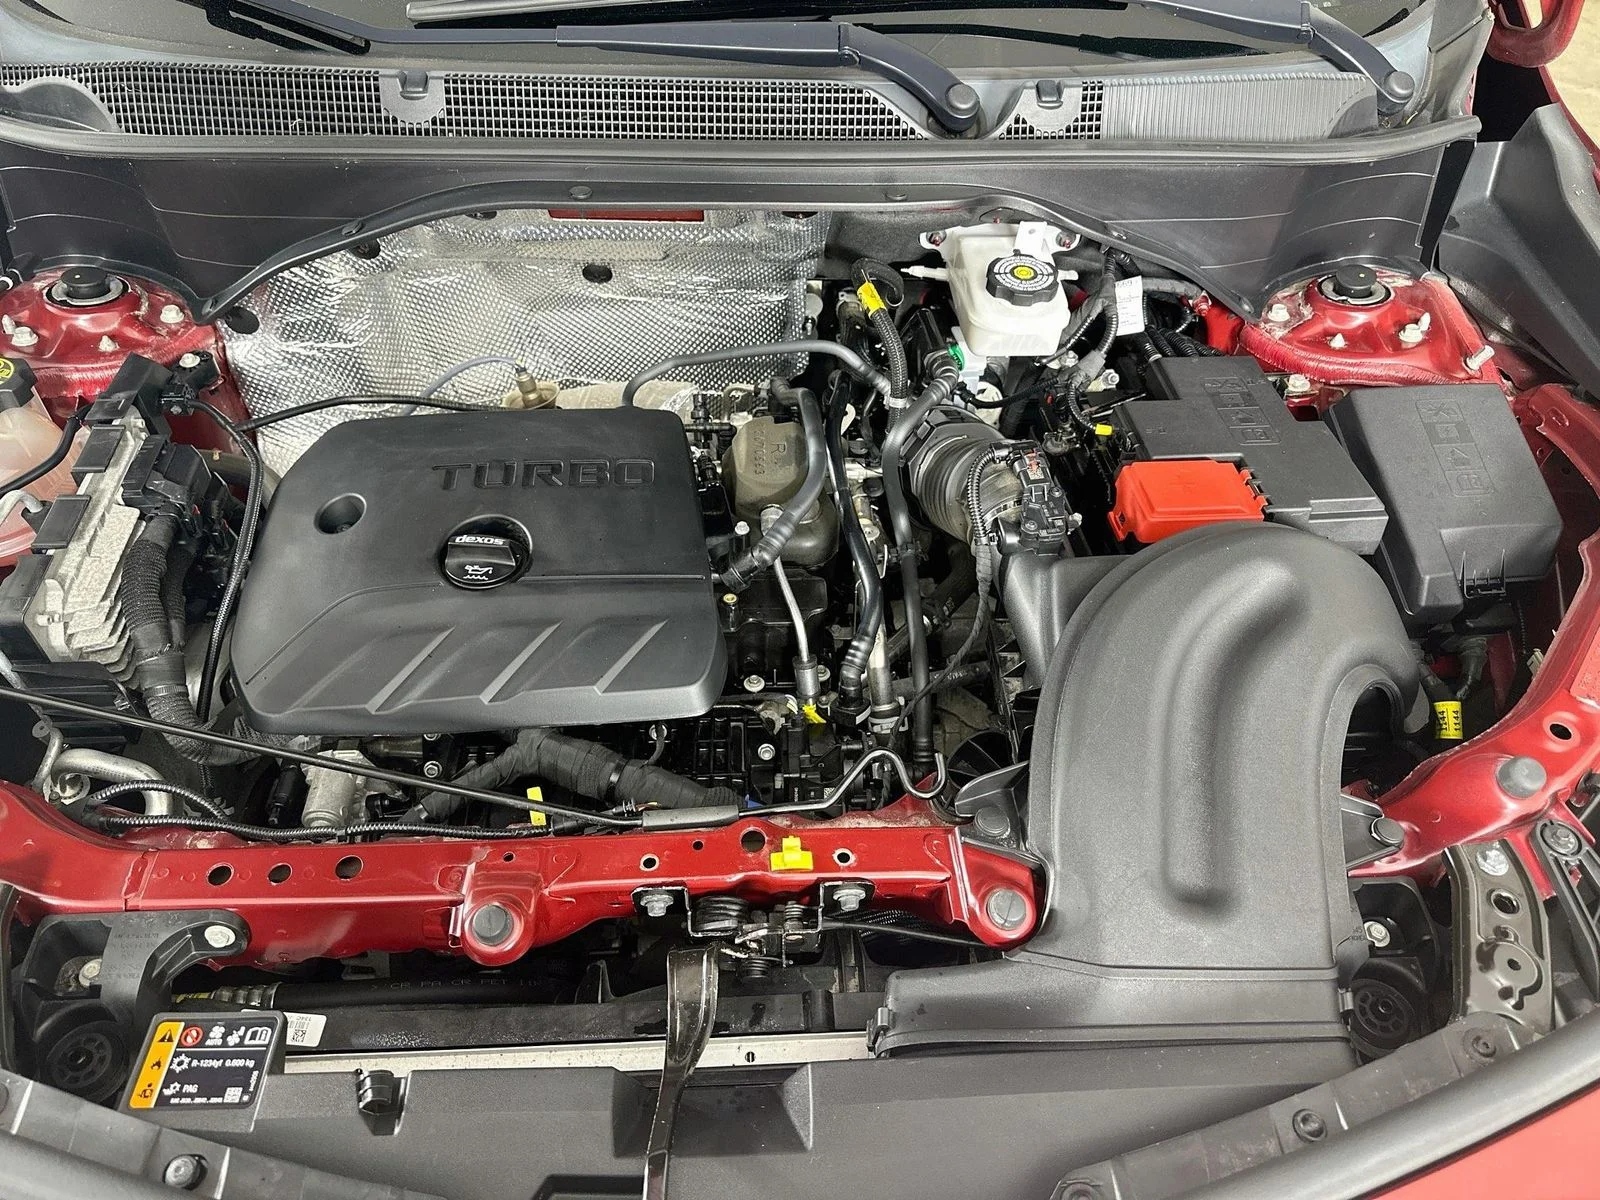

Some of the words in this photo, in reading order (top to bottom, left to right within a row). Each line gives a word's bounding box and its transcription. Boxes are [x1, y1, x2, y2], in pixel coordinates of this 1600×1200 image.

[432, 459, 655, 490] TURBO
[455, 535, 505, 545] dexos
[1452, 710, 1461, 731] 1144
[205, 1038, 223, 1046] AUTO
[191, 1059, 224, 1068] R-1234yf
[245, 1059, 255, 1068] kg
[182, 1084, 199, 1094] PAG
